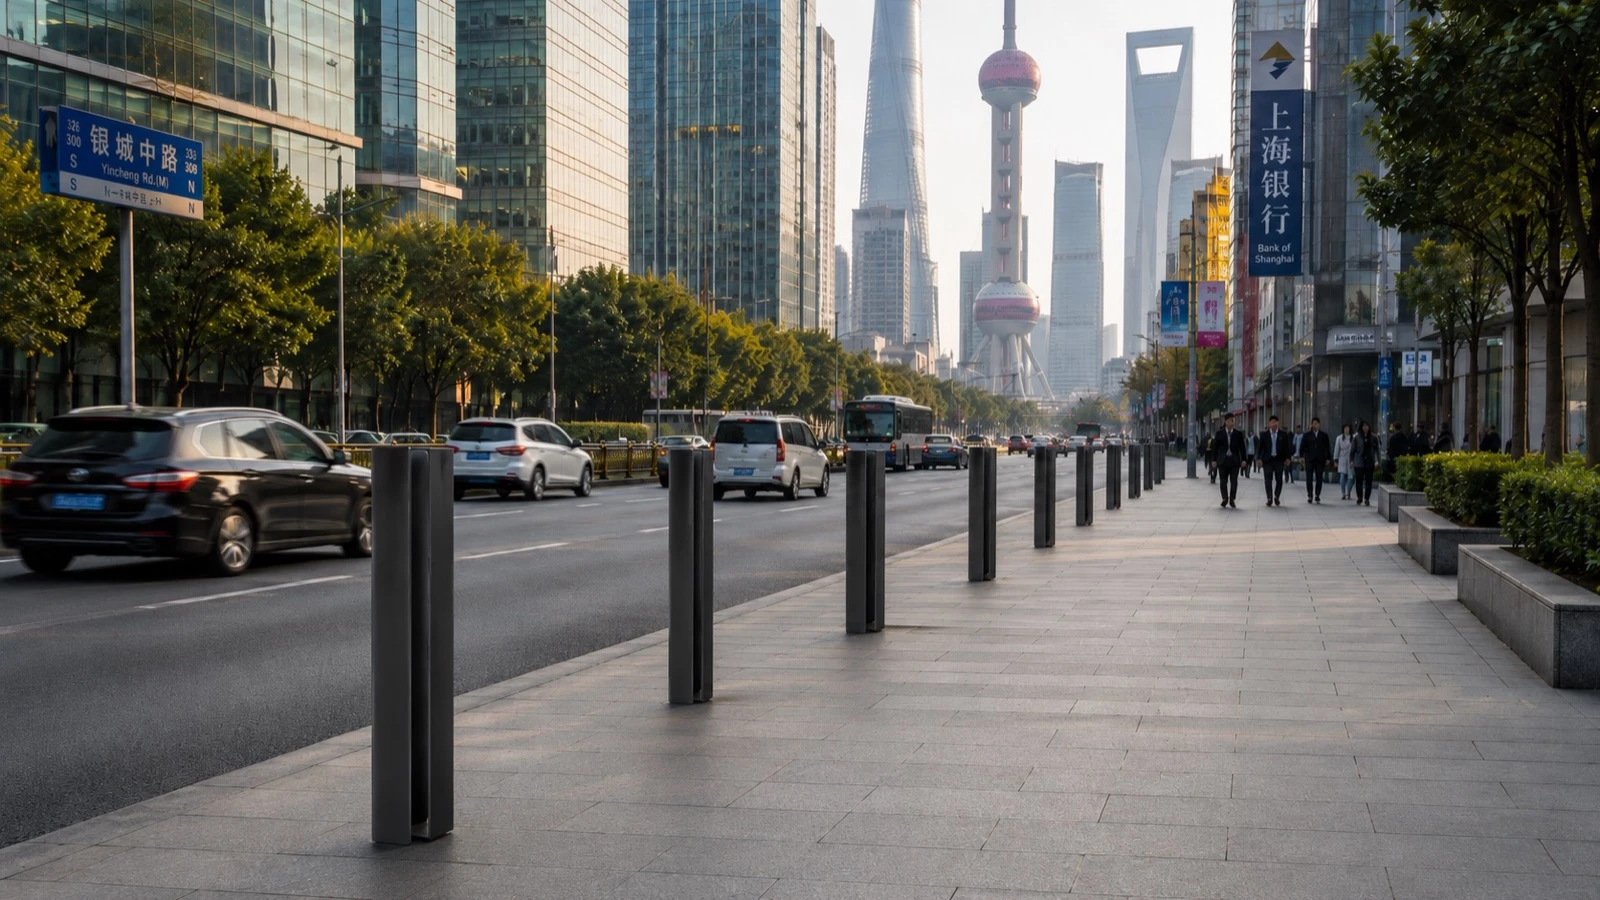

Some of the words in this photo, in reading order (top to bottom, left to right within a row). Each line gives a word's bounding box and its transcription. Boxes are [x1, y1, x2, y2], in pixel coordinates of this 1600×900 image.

[66, 133, 81, 148] 300
[89, 123, 178, 174] 银城中路
[70, 153, 77, 168] S
[101, 162, 140, 184] Yincheng
[1260, 102, 1292, 235] 上海银行
[70, 177, 77, 191] S
[188, 179, 195, 194] N
[188, 201, 195, 214] N
[1257, 243, 1280, 252] Bank
[1281, 243, 1291, 252] of
[1255, 253, 1295, 265] Shanghai
